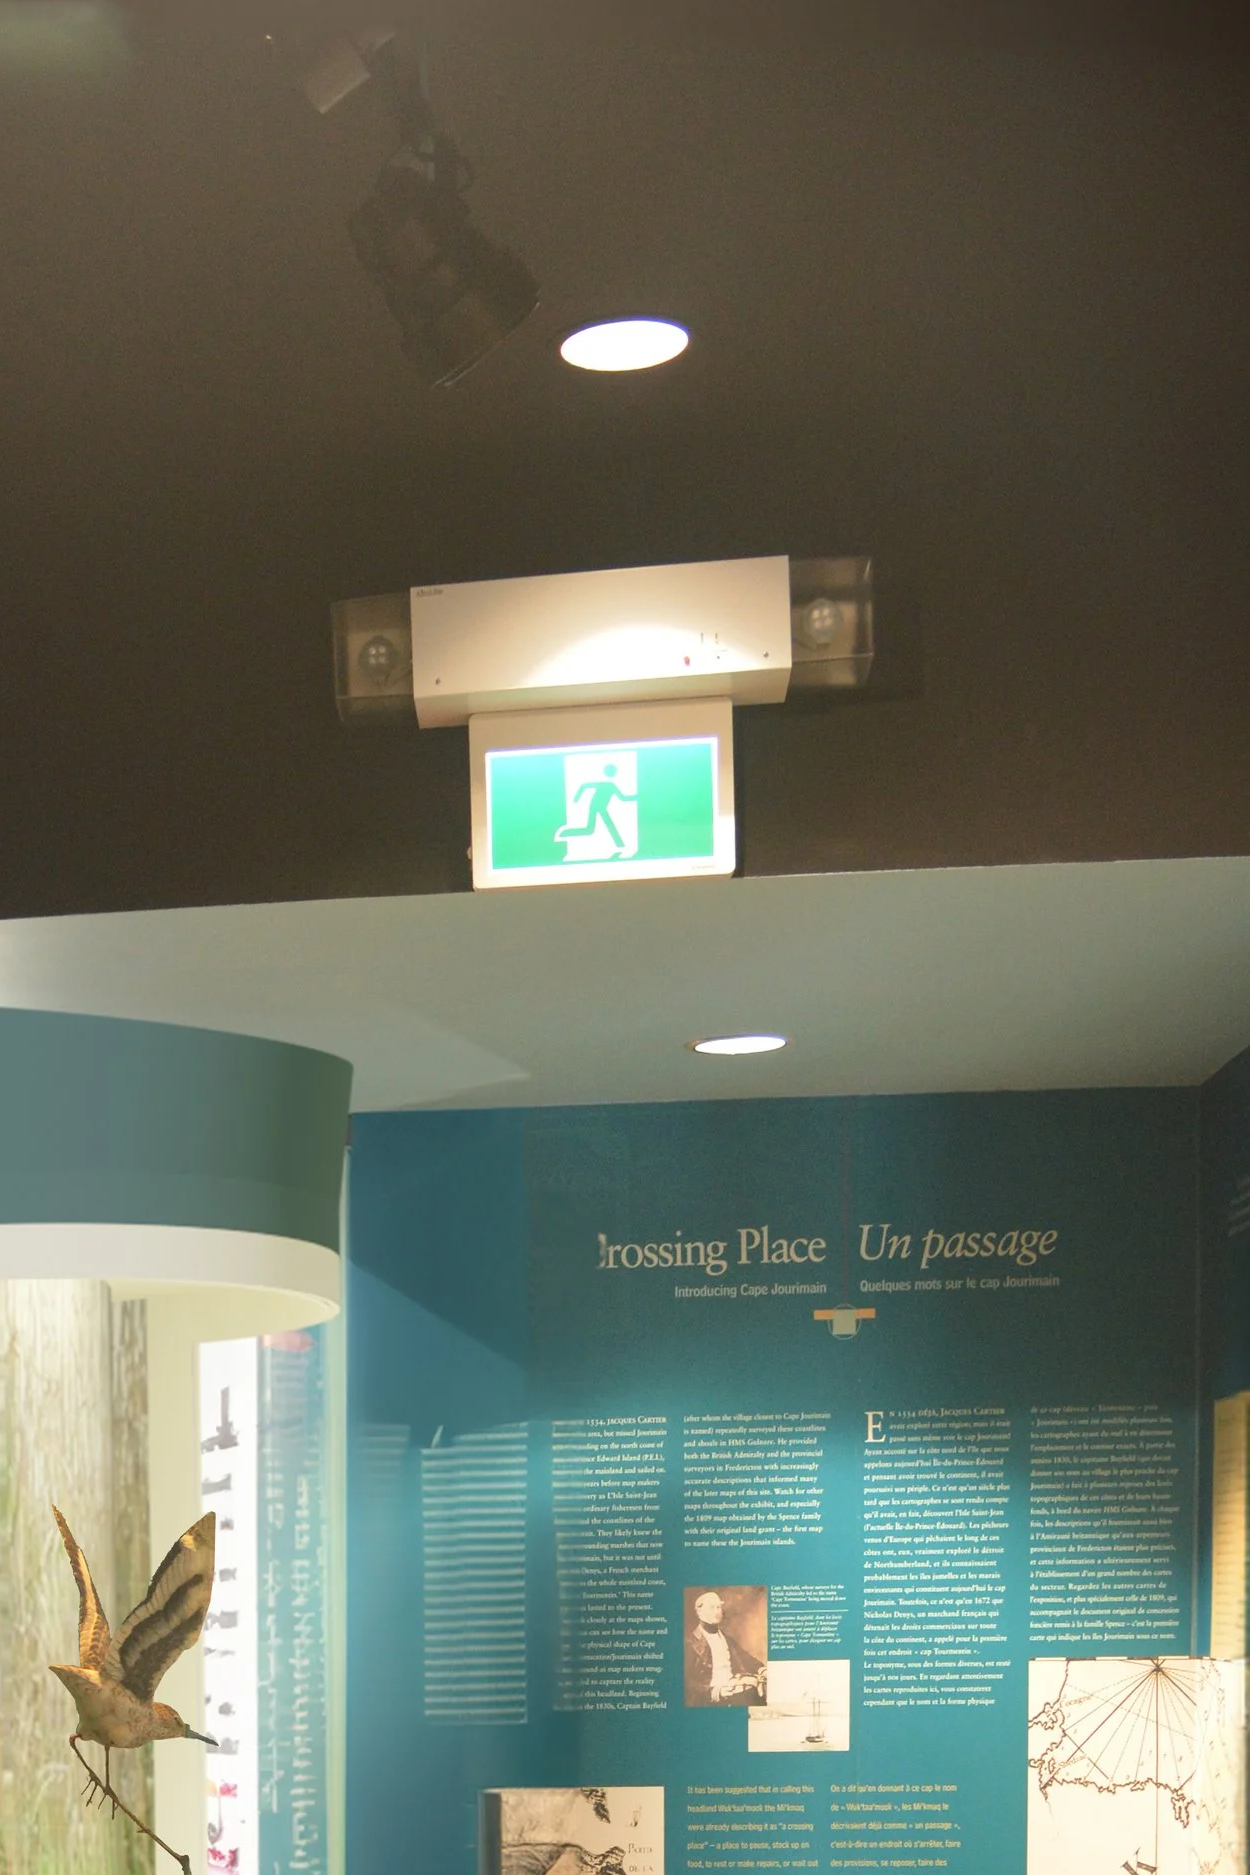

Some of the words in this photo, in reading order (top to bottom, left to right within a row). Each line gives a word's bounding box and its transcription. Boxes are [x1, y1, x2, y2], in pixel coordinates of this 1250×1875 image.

[737, 1225, 826, 1264] Place
[859, 1223, 911, 1261] Un
[920, 1229, 1058, 1269] passage
[674, 1285, 737, 1298] Introducing
[740, 1284, 768, 1297] Cape
[771, 1282, 827, 1296] Jourimain
[860, 1279, 911, 1293] Quelques
[914, 1278, 942, 1290] mots
[945, 1279, 963, 1290] sur
[966, 1276, 976, 1289] le
[980, 1278, 999, 1291] cap
[1003, 1275, 1060, 1287] Jourimain
[864, 1411, 886, 1443] E
[700, 1451, 709, 1459] the
[711, 1451, 732, 1459] British
[734, 1450, 764, 1459] Admiralty
[780, 1449, 789, 1457] the
[791, 1449, 823, 1458] provincial
[725, 1463, 761, 1471] Fredericton
[763, 1462, 778, 1470] with
[780, 1462, 819, 1471] increasingly
[712, 1476, 751, 1484] descriptions
[753, 1475, 766, 1483] that
[768, 1474, 797, 1482] informed
[684, 1503, 700, 1511] maps
[702, 1501, 737, 1510] throughout
[739, 1500, 748, 1508] the
[790, 1499, 821, 1508] especially
[684, 1514, 694, 1522] the
[728, 1513, 755, 1521] obtained
[757, 1513, 765, 1521] by
[767, 1512, 776, 1520] the
[778, 1512, 799, 1521] Spence
[801, 1511, 822, 1520] family
[740, 1538, 770, 1546] Jourimain
